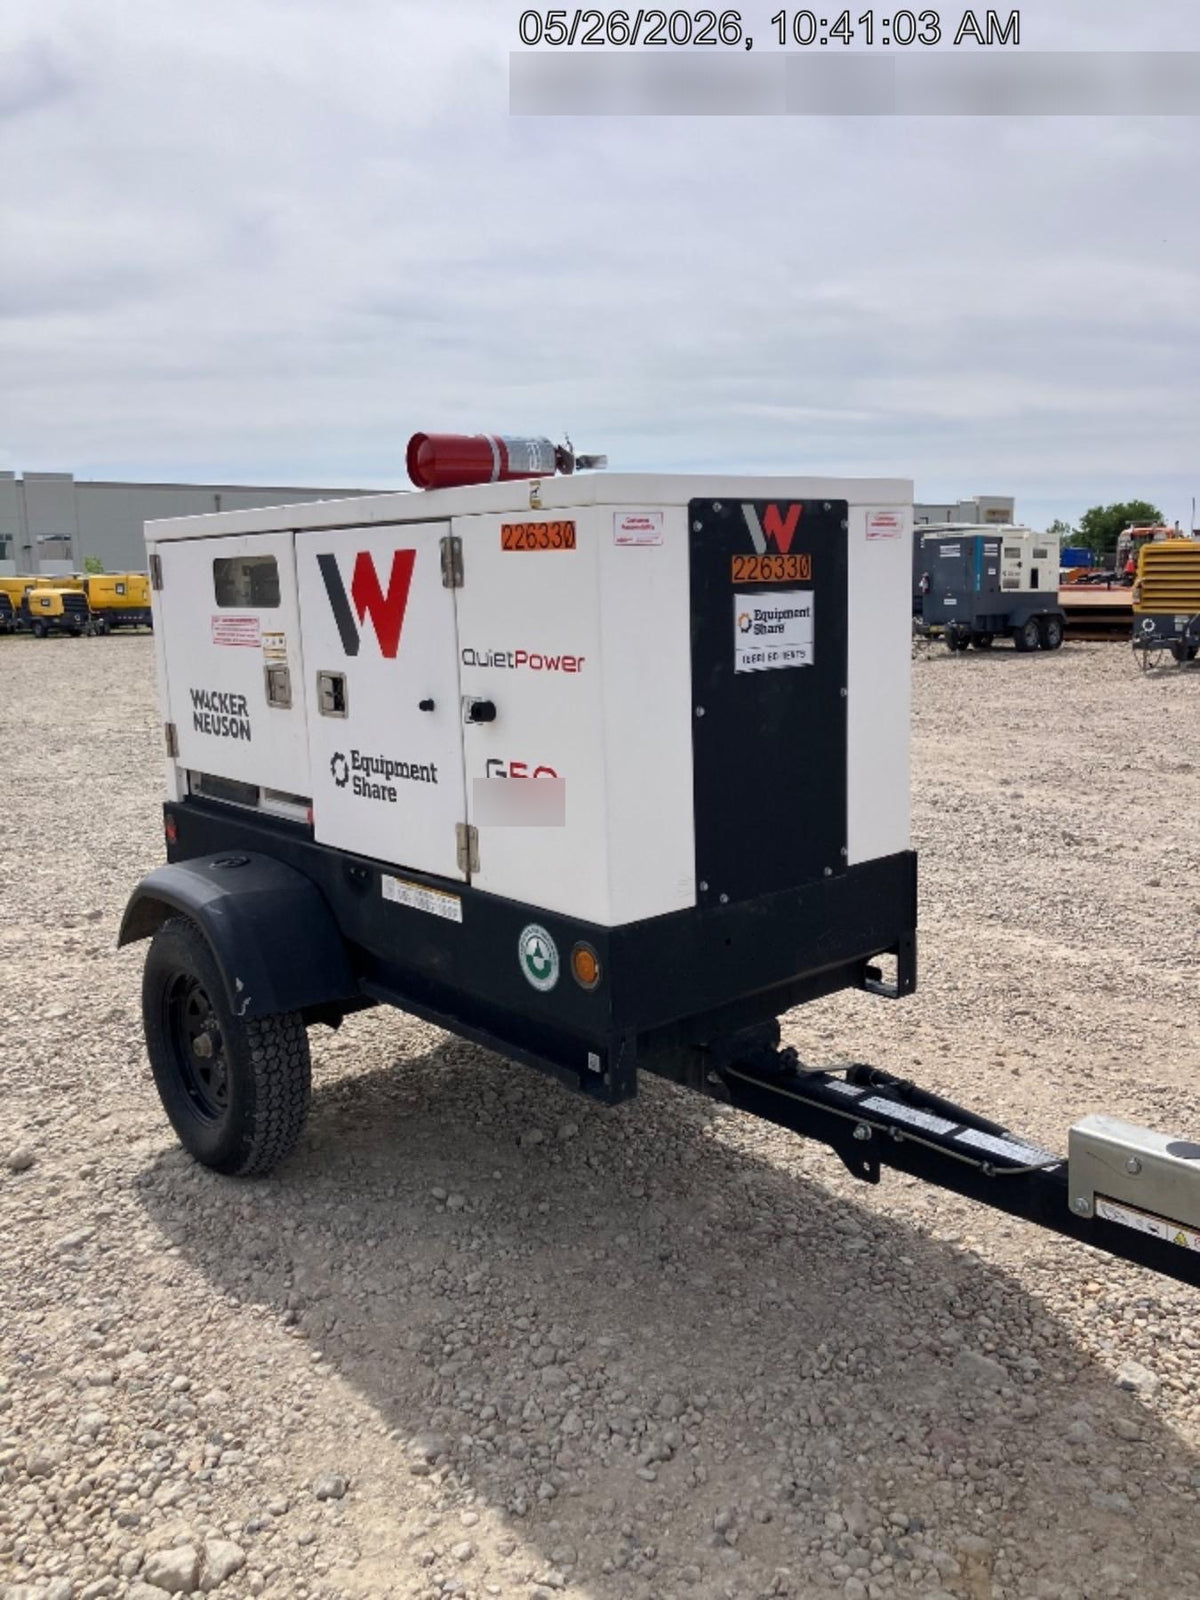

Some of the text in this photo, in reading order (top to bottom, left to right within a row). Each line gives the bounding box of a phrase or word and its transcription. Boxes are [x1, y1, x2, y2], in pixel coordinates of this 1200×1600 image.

[502, 521, 576, 550] 226330
[733, 555, 810, 581] 226330
[753, 621, 785, 636] Share
[754, 607, 811, 624] Equipment
[462, 648, 586, 673] QuietPower
[189, 688, 248, 718] WACKER
[193, 711, 252, 742] NEUSON
[350, 750, 438, 785] Equipment
[352, 778, 397, 803] Share
